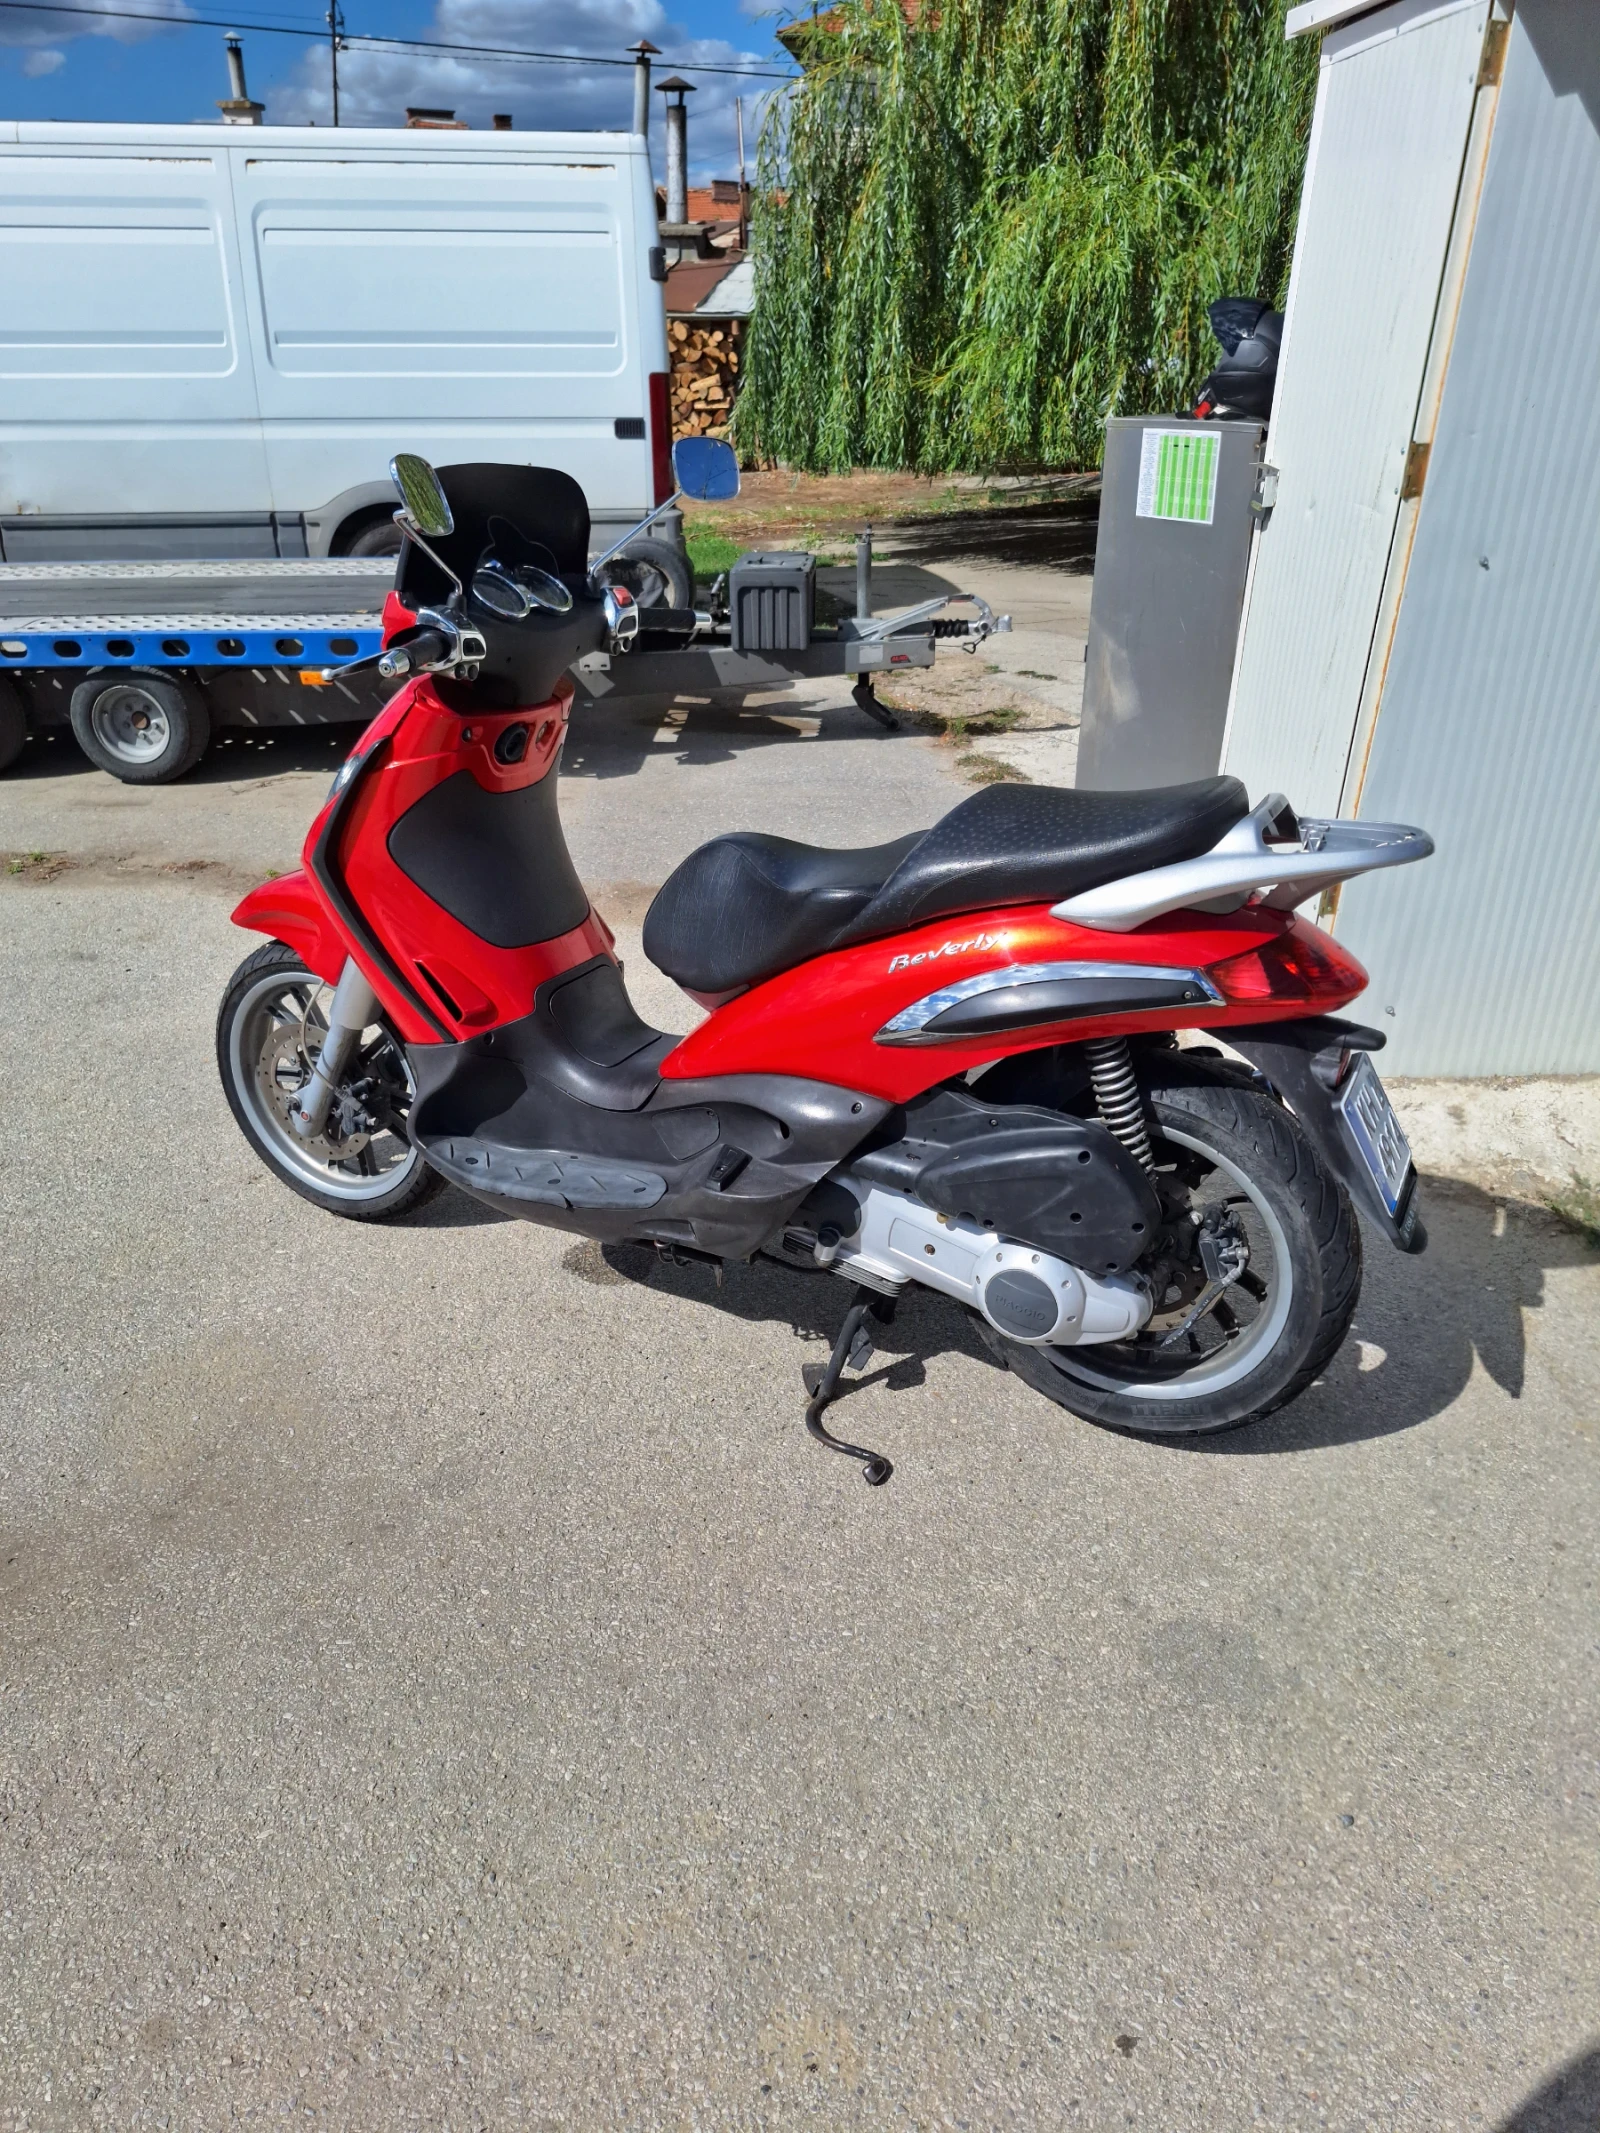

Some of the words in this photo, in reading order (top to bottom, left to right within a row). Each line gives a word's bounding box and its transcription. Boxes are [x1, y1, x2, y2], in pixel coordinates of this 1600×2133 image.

[888, 932, 1007, 974] Beverly
[1377, 1107, 1408, 1181] 4914
[995, 1294, 1047, 1321] PIAGGIO
